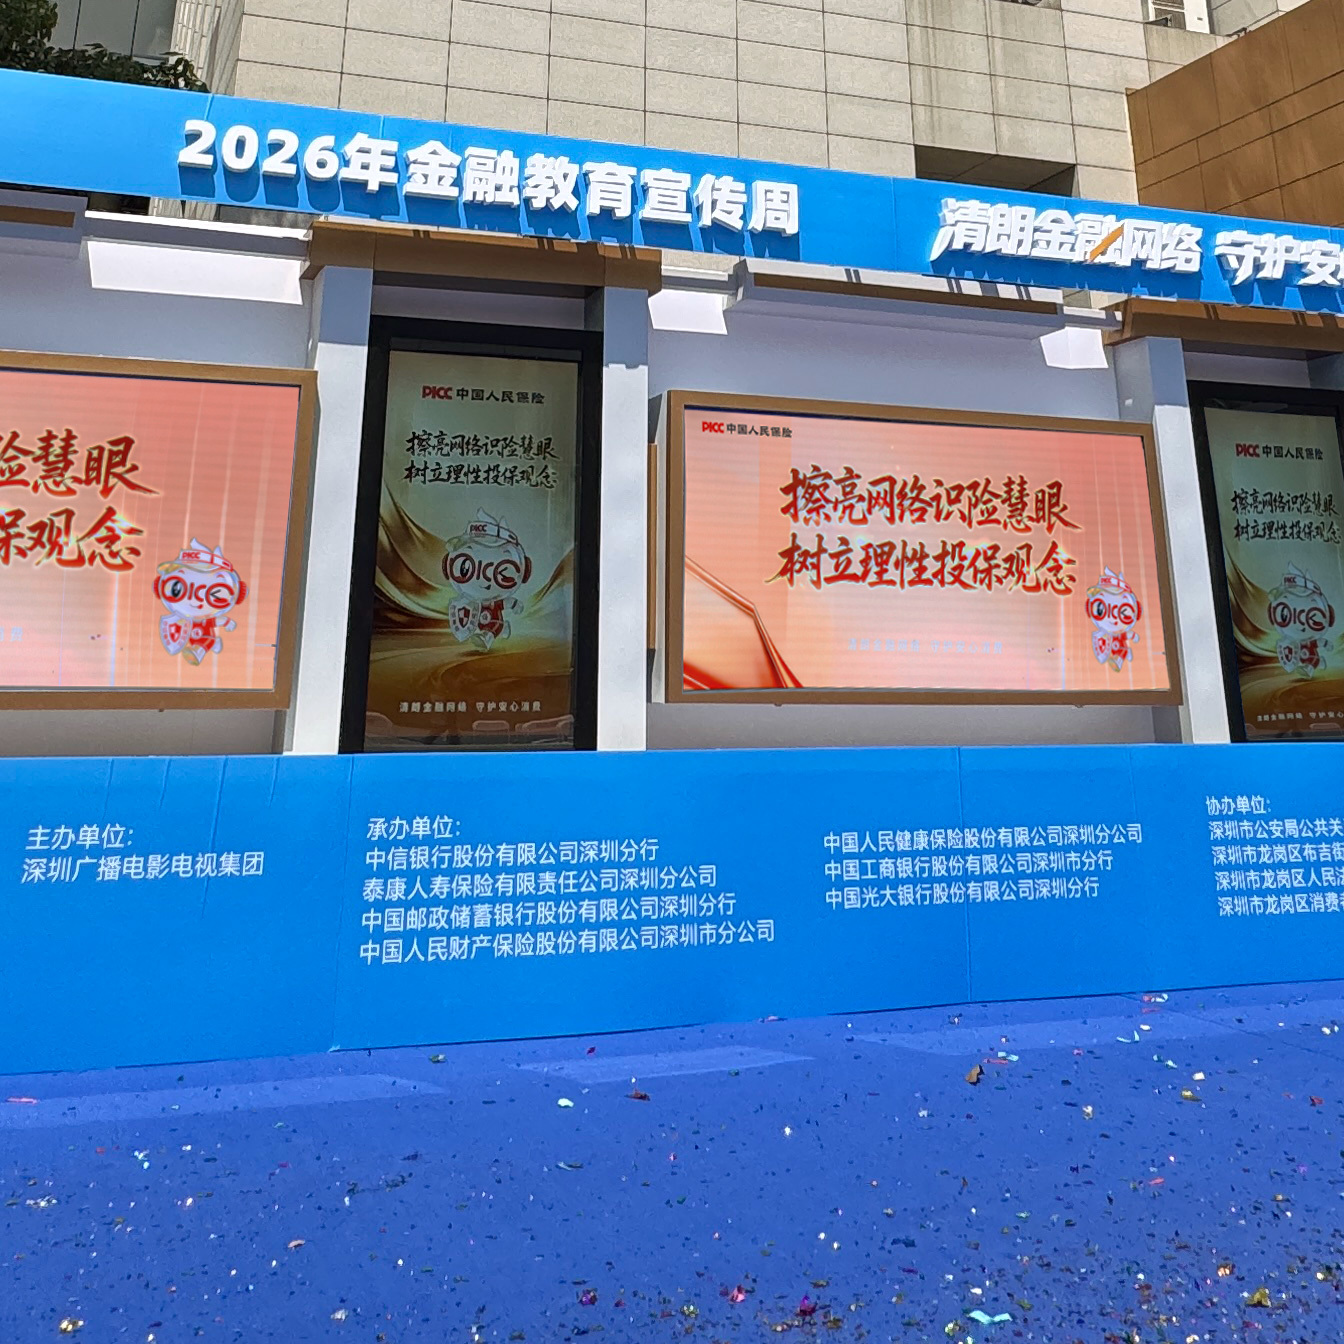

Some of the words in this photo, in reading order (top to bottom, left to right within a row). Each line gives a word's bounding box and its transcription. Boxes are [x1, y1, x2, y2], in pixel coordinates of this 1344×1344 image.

[178, 119, 800, 236] 2026年金融教育宣传周
[930, 197, 1204, 274] 清朗金融网络
[422, 385, 453, 400] PICC
[456, 387, 545, 404] 中国人民保险
[405, 431, 560, 460] 擦亮网络识险慧眼
[701, 421, 725, 434] PICC
[726, 423, 792, 438] 中国人民保险
[1235, 443, 1260, 458] PICC
[1262, 444, 1323, 461] 中国人民保险
[402, 460, 559, 489] 树立理性投保观念
[779, 464, 1082, 535] 擦亮网络识险慧眼
[1231, 489, 1341, 518] 擦亮网络识险慧眼
[1233, 520, 1341, 545] 树立理性投保观念
[765, 534, 1078, 597] 树立理性投保观念
[365, 838, 659, 871] 中信银行股份有限公司深圳分行
[823, 823, 1142, 854] 中国人民健康保险股份有限公司深圳分公司
[21, 851, 265, 883] 深圳广播电影电视集团
[824, 850, 1113, 881] 中国工商银行股份有限公司深圳市分行
[362, 864, 716, 902] 泰康人寿保险有限责任公司深圳分公司
[825, 876, 1100, 909] 中国光大银行股份有限公司深圳分行
[361, 892, 736, 933] 中国邮政储蓄银行股份有限公司深圳分行
[359, 919, 774, 965] 中国人民财产保险股份有限公司深圳市分公司
